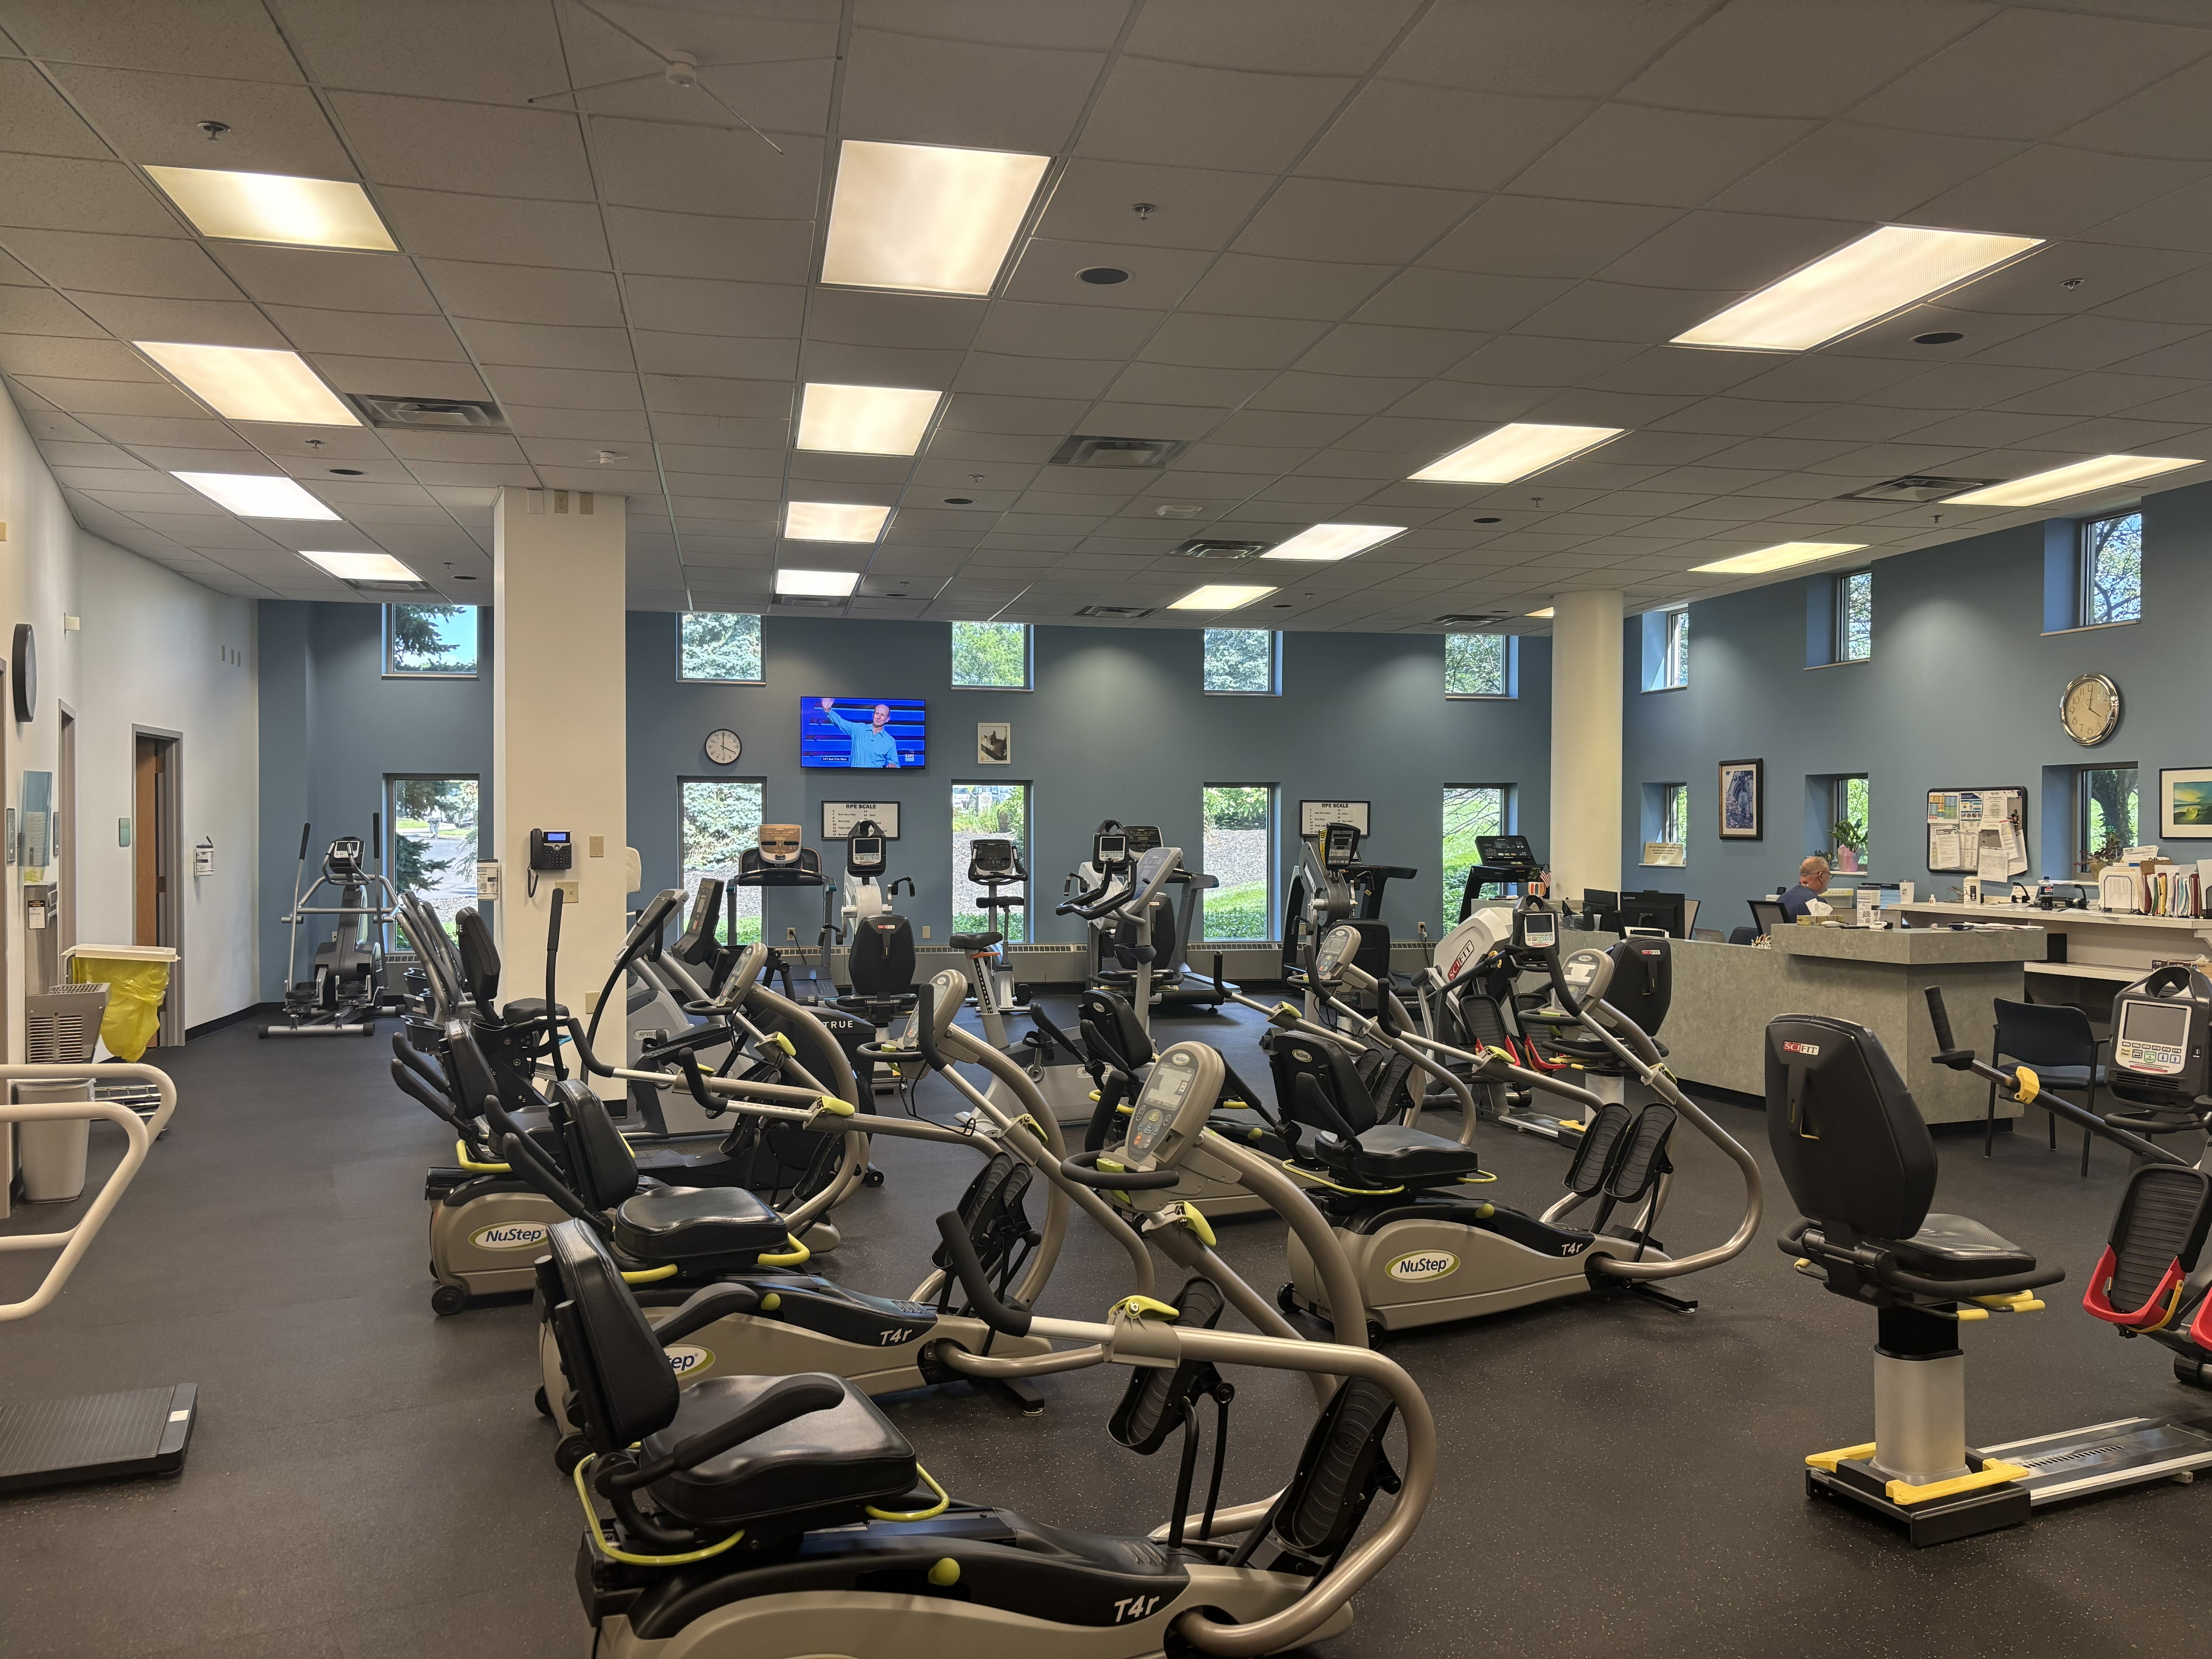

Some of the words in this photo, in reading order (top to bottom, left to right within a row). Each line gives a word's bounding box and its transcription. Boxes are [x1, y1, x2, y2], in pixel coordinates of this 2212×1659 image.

[2073, 696, 2080, 704] 10
[2072, 716, 2078, 725] 8
[2080, 724, 2084, 732] 7
[1449, 944, 1471, 980] SCIFIT
[823, 1020, 853, 1029] TRUE
[1784, 1042, 1817, 1053] SCIFIT
[1296, 1051, 1308, 1060] NuStep
[1561, 1242, 1583, 1255] T4r
[1400, 1258, 1447, 1273] NuStep
[880, 1328, 913, 1345] T4r
[1114, 1595, 1160, 1623] T4r
